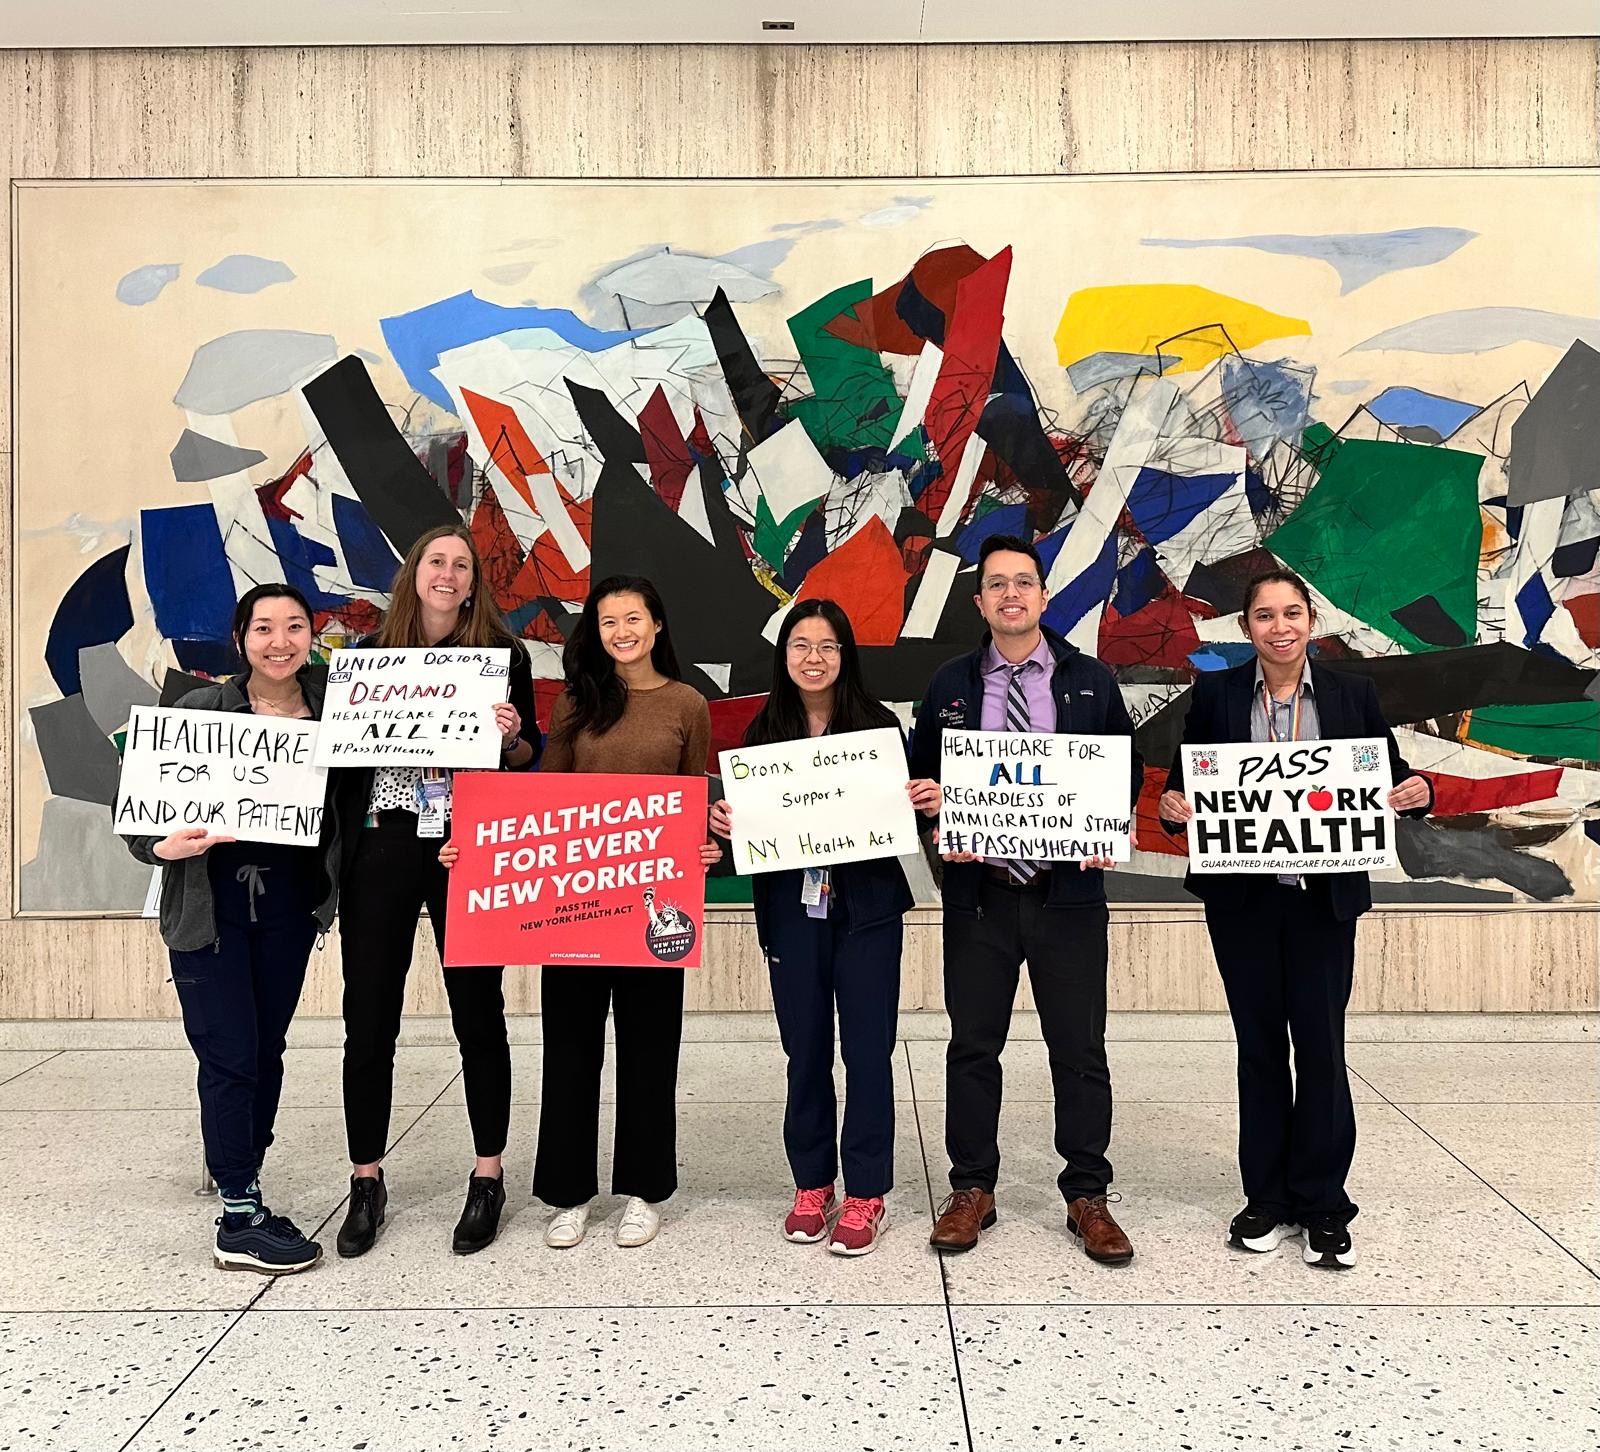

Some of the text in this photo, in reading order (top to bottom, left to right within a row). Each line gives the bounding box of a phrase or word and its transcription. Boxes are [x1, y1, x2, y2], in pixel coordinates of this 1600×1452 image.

[336, 652, 492, 672] UNION DOCTORS
[349, 681, 457, 706] DEMAND
[332, 710, 478, 721] HEALTHCARE FOR
[133, 714, 309, 764] HEALTHCARE
[361, 723, 428, 740] ALL
[944, 735, 1105, 760] HEALTHCARE FOR
[160, 762, 269, 784] FOR US
[730, 749, 878, 780] Bronx doctors
[989, 762, 1058, 786] ALL
[1238, 746, 1332, 787] PASS
[943, 785, 1077, 808] REGARDLESS OF
[1193, 789, 1273, 814] NEW
[119, 796, 324, 836] AND OUR PATIENTS
[475, 790, 683, 847] HEALTHCARE
[945, 810, 1131, 835] IMMIGRATION STATUS
[1196, 815, 1386, 854] HEALTH
[493, 826, 664, 877] FOR EVERY
[748, 831, 896, 865] NY Health Act
[1201, 859, 1261, 869] GUARANTEED
[1263, 859, 1320, 869] HEALTHCARE
[1321, 859, 1340, 868] FOR
[1341, 858, 1356, 867] ALL
[1358, 857, 1372, 866] OF
[1372, 856, 1385, 865] US
[467, 857, 684, 913] NEW YORKER.
[520, 905, 633, 931] NEW YORK HEALTH ACT
[554, 899, 600, 915] PASS THE
[653, 938, 689, 949] NEW YORK
[657, 945, 684, 954] HEALTH
